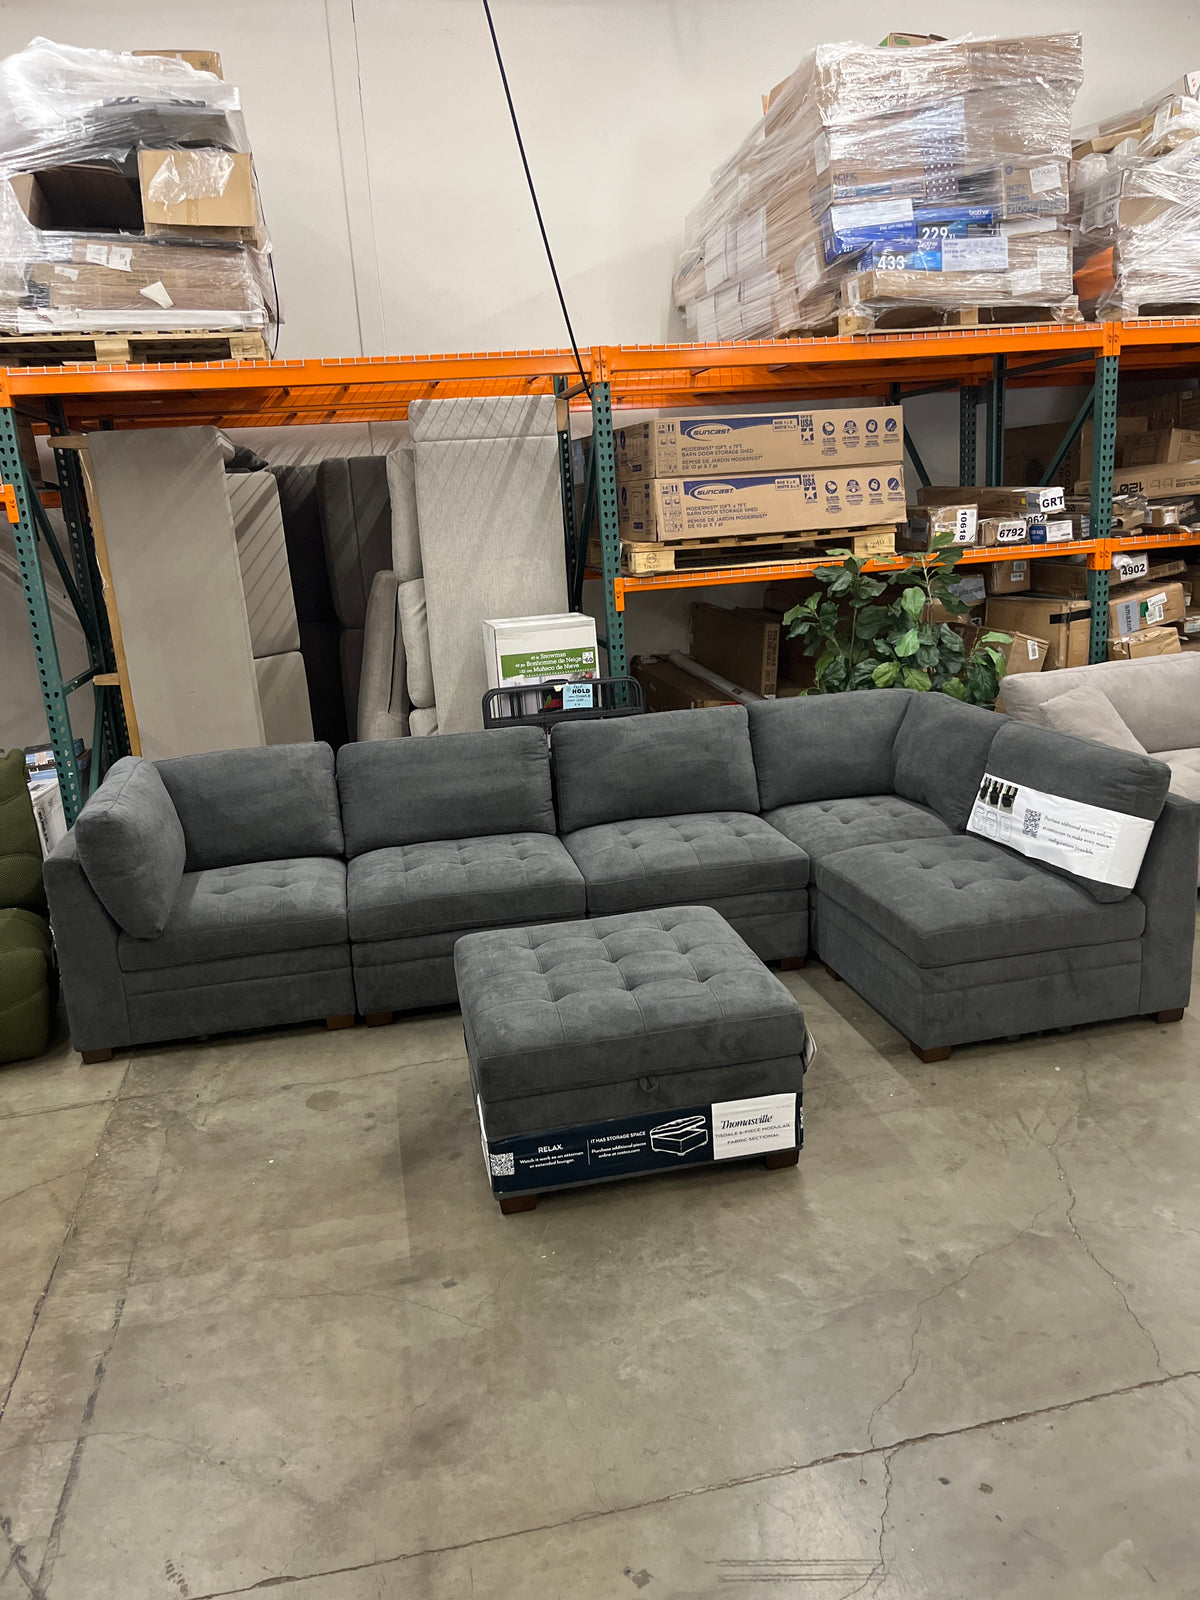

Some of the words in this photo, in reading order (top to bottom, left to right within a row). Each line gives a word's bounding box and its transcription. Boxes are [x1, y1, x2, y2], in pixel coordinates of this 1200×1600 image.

[877, 255, 906, 270] 433
[801, 418, 814, 428] USA
[803, 478, 816, 487] USA
[1042, 496, 1064, 509] GRT
[958, 511, 968, 541] 10618
[1000, 527, 1024, 538] 6792
[1124, 604, 1132, 633] amazon
[526, 659, 557, 667] Bonhomme
[1095, 841, 1110, 849] more
[720, 1114, 773, 1130] Thomasville
[606, 1133, 630, 1142] STORAGE
[630, 1130, 646, 1138] SPACE
[715, 1131, 738, 1140] TISDALE
[761, 1123, 791, 1132] MODULAR
[748, 1133, 779, 1142] SECTIONAL
[612, 1142, 633, 1151] additional
[535, 1159, 557, 1168] extended
